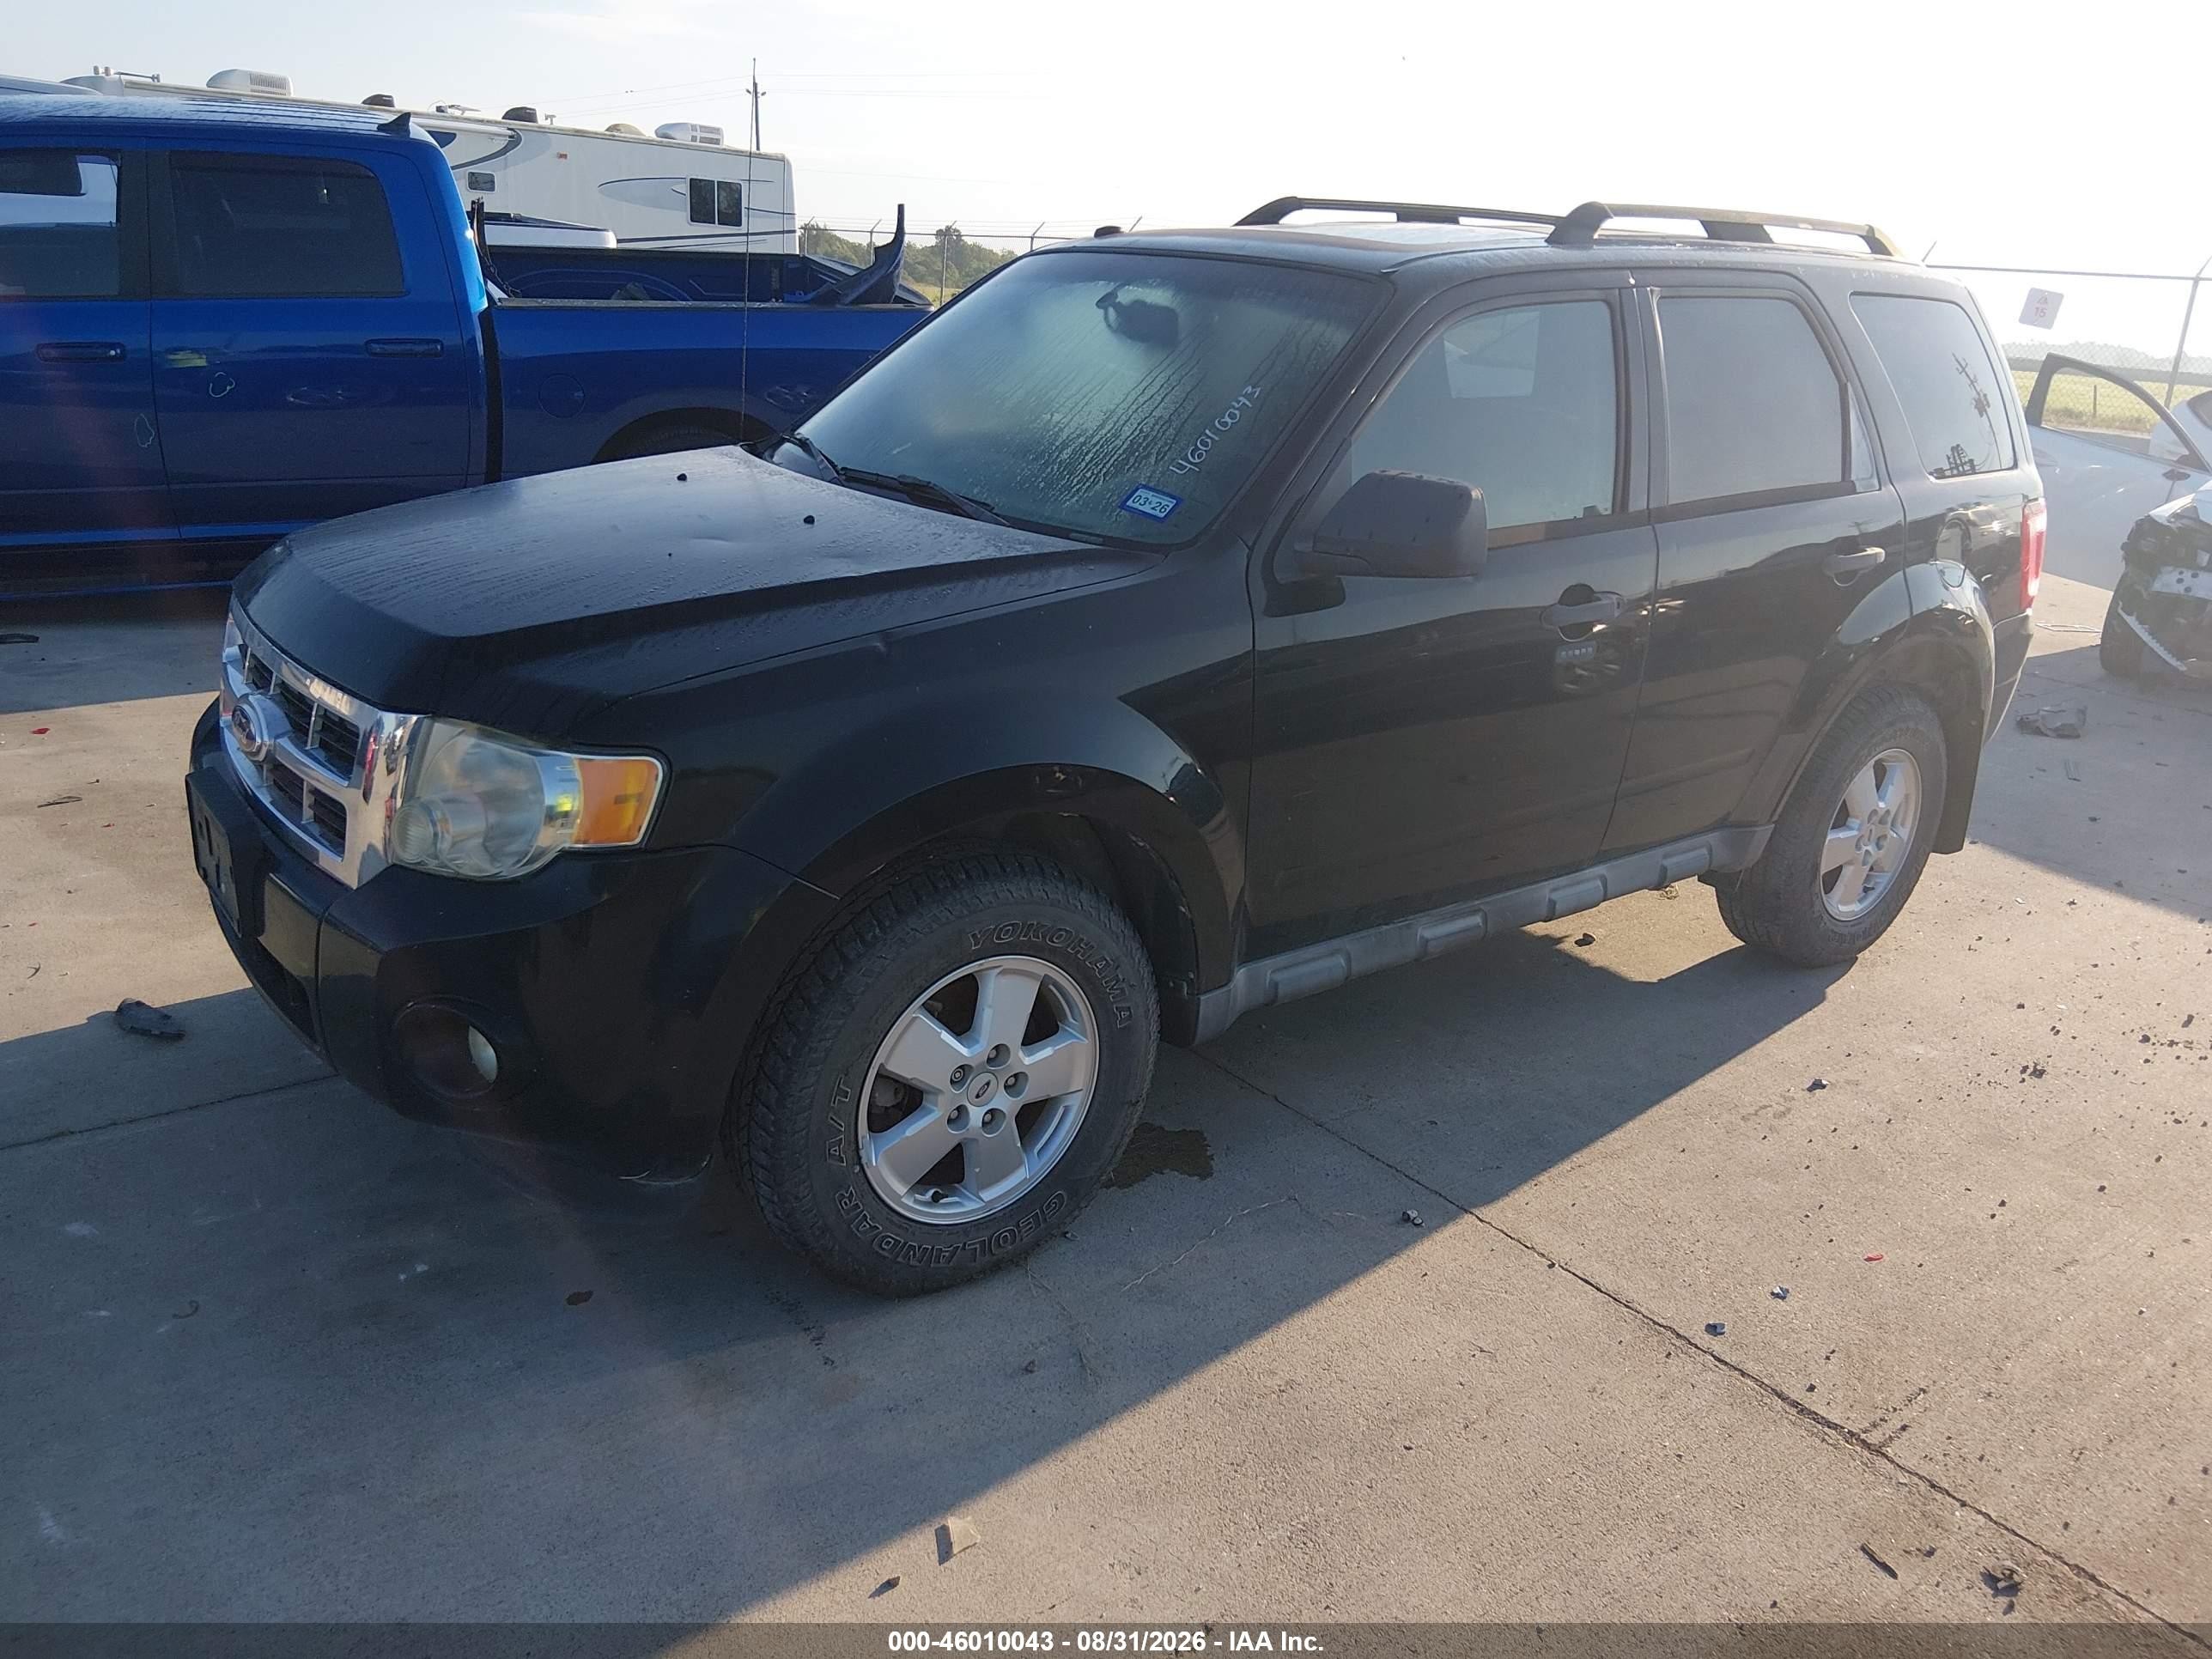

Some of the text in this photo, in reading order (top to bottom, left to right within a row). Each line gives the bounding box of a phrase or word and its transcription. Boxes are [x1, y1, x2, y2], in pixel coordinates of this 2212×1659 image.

[1169, 385, 1261, 474] 46010043
[968, 921, 1134, 1029] YOKOHAMA
[825, 1075, 1067, 1268] GEOLANDAR A/T
